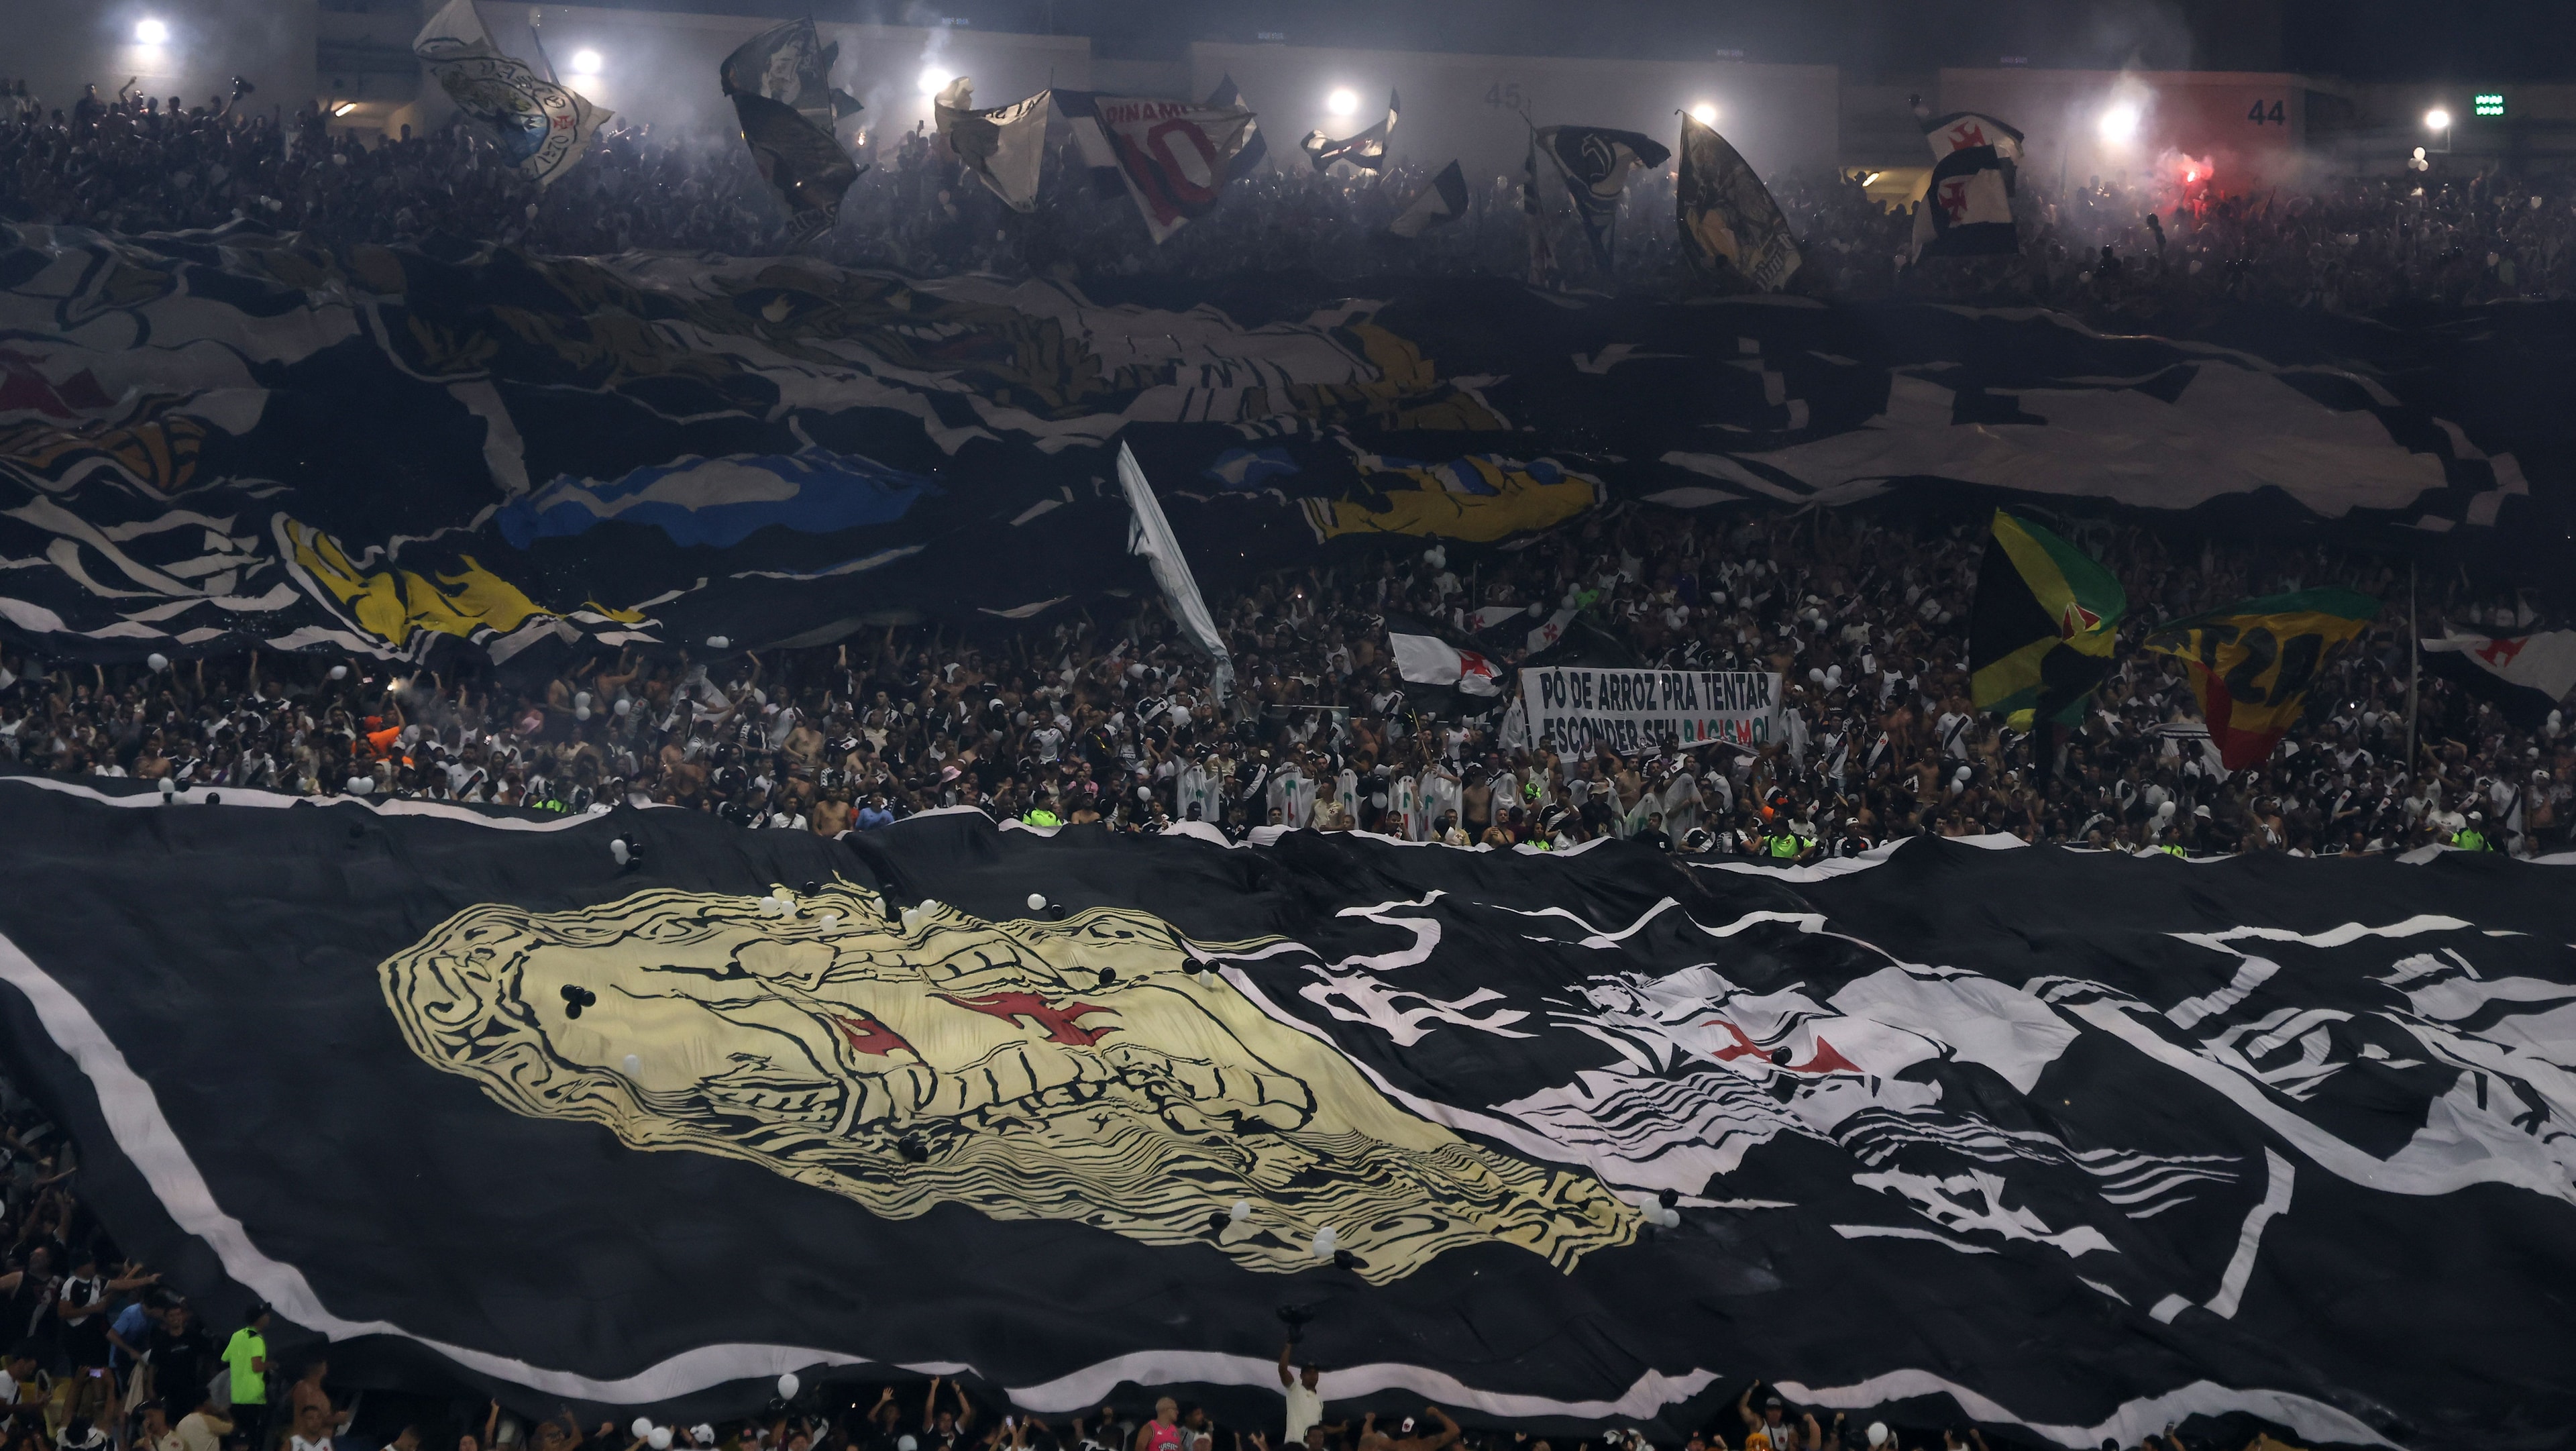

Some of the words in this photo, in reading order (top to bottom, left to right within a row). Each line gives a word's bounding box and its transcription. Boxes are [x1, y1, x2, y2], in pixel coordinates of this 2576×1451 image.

[1485, 83, 1521, 109] 45
[2248, 100, 2286, 125] 44
[1570, 672, 1593, 710] DE
[1599, 673, 1656, 711] ARROZ
[1662, 673, 1698, 710] PRA
[1701, 673, 1771, 711] TENTAR
[1544, 716, 1640, 753] ESCONDER
